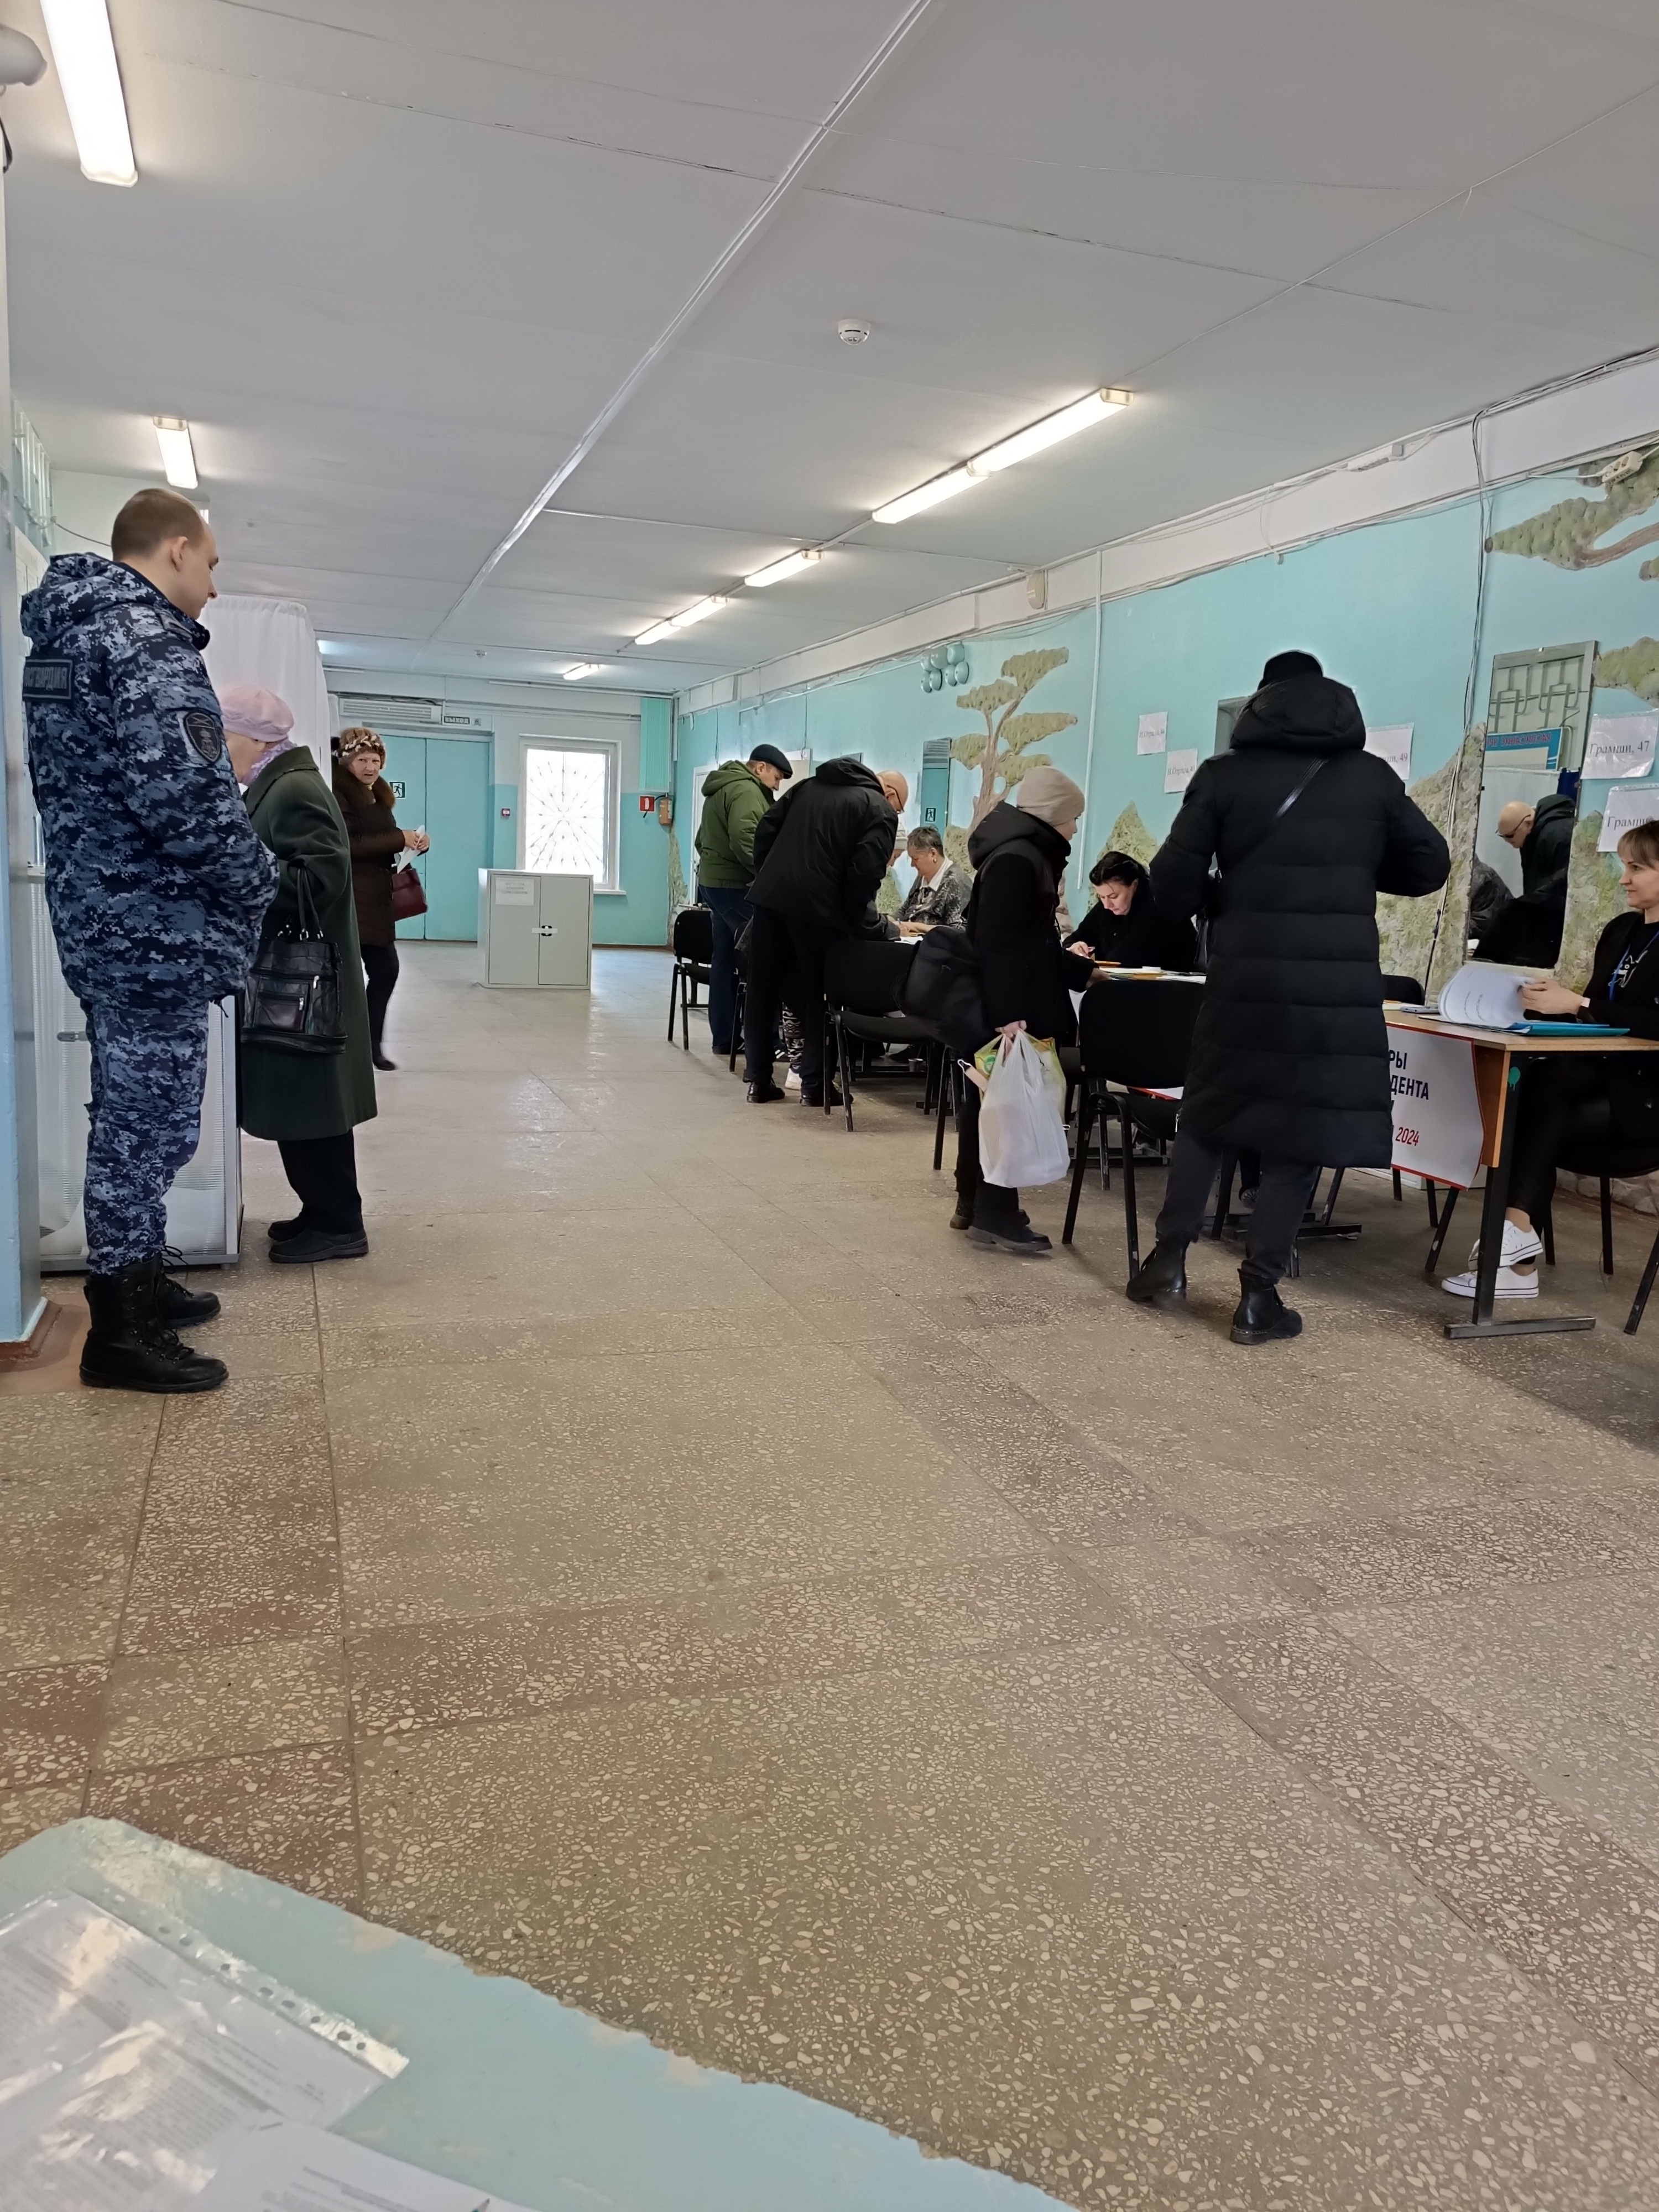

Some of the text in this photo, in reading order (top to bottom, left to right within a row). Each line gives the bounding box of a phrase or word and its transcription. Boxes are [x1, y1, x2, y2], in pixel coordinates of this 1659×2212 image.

[1400, 753, 1408, 761] 49
[1590, 740, 1650, 757] Грамши, 47
[1607, 816, 1650, 830] Грамш
[1391, 1075, 1429, 1100] ДЕНТА
[1395, 1126, 1420, 1146] 2024
